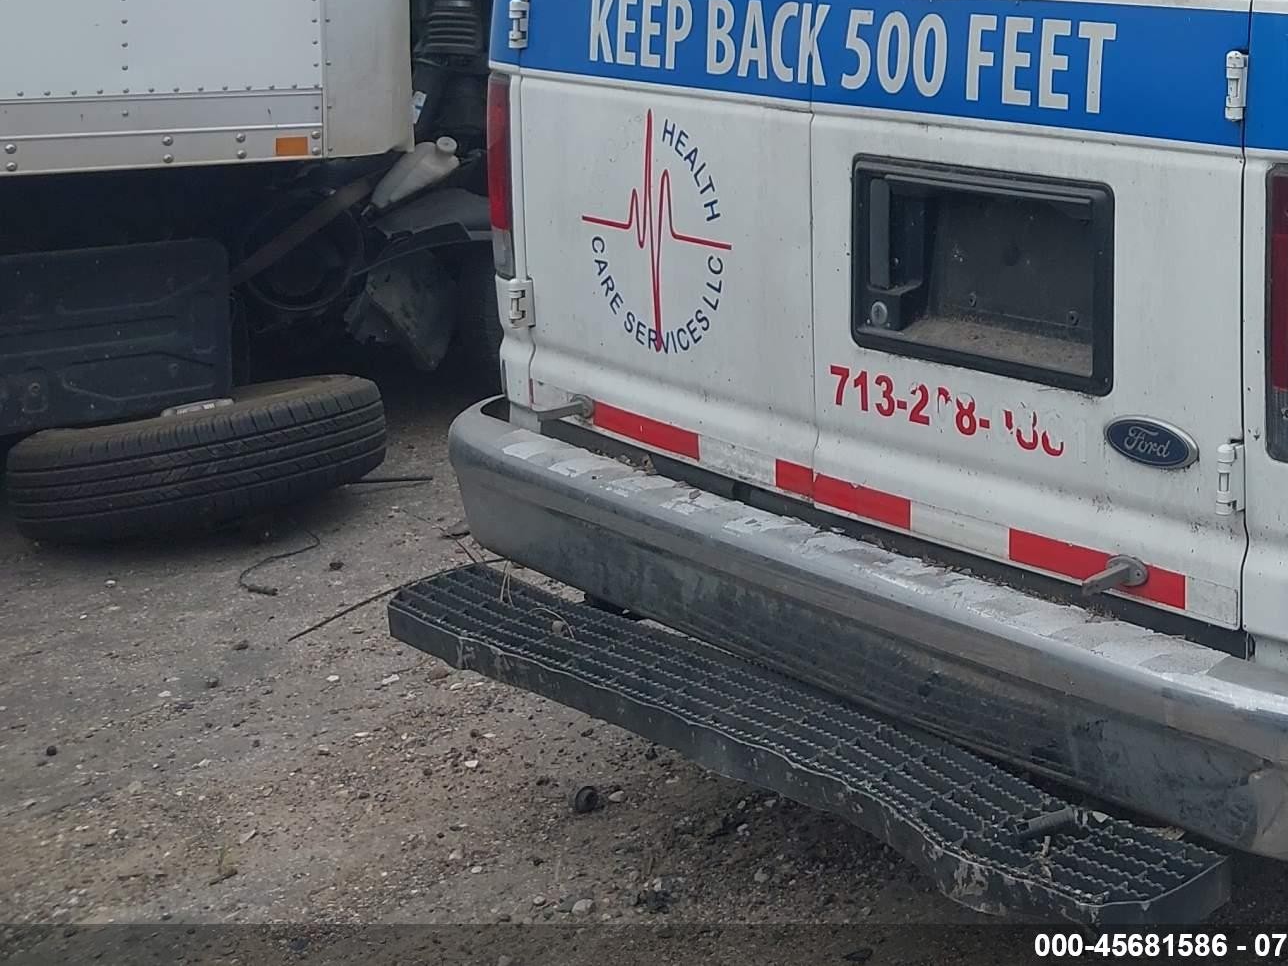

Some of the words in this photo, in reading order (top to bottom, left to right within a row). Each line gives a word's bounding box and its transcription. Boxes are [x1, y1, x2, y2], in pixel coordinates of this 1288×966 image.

[840, 9, 949, 97] 500
[965, 13, 1117, 114] FEET
[662, 118, 721, 222] HEALTH
[591, 236, 624, 315] CARE
[624, 309, 710, 355] SERVICES
[702, 255, 724, 311] LLC
[1123, 424, 1171, 459] Ford
